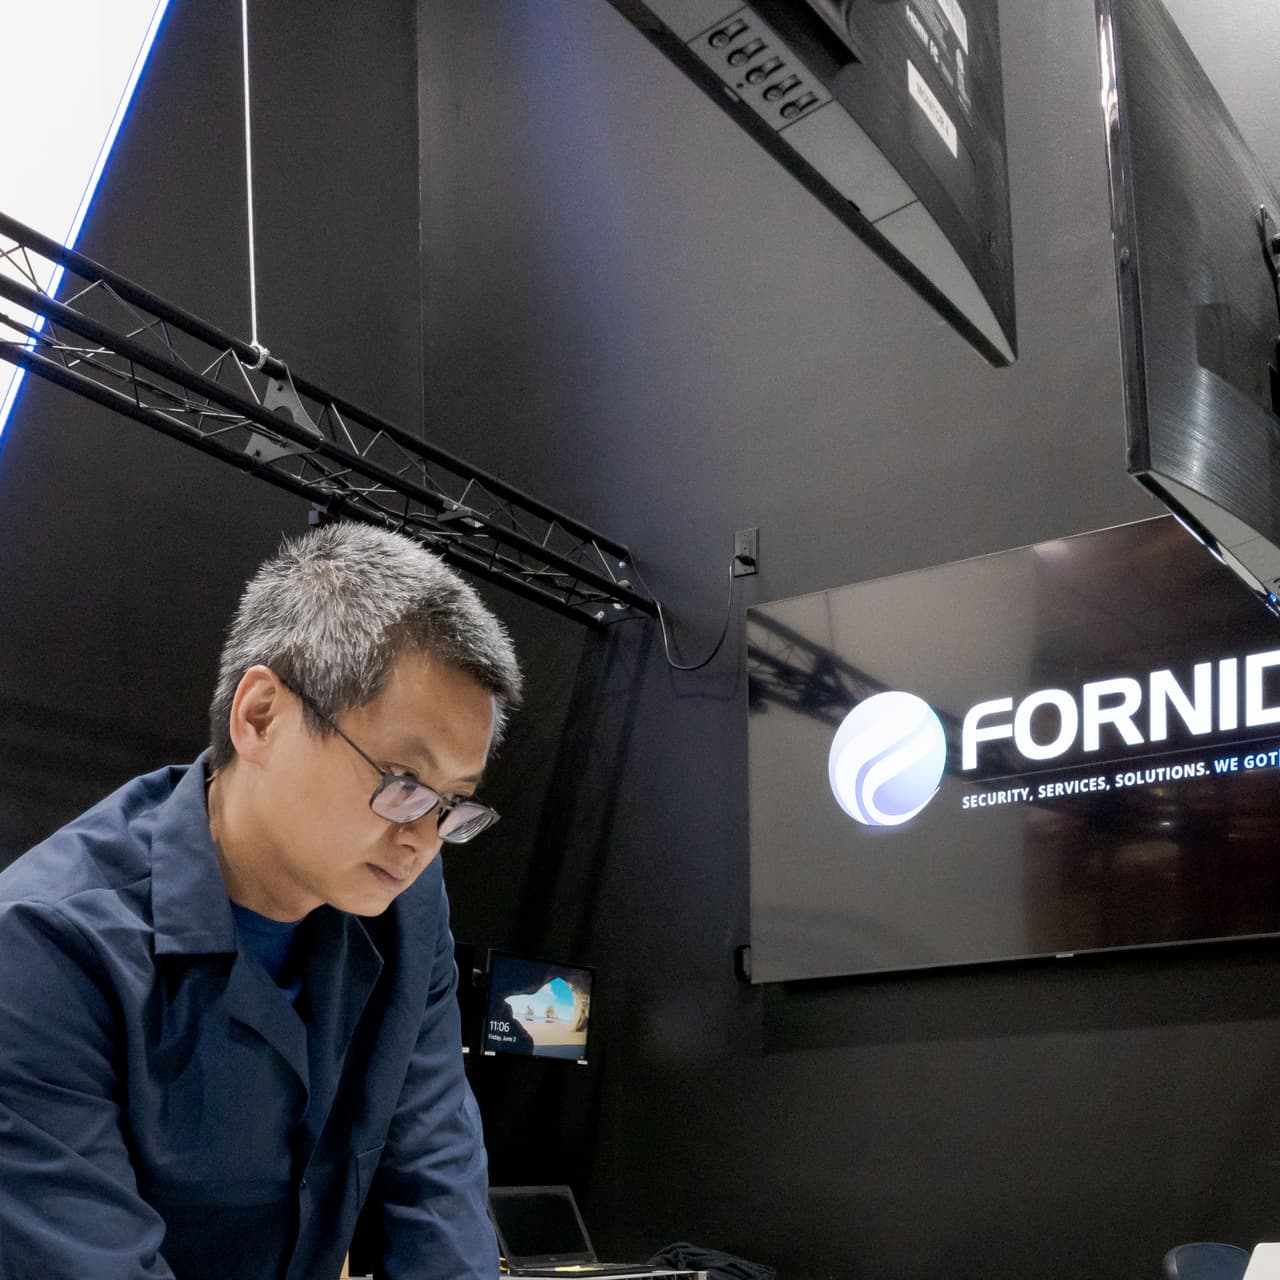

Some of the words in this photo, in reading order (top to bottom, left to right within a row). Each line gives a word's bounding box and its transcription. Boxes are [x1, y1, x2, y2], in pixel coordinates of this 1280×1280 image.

[962, 786, 1034, 809] SECURITY,
[1037, 775, 1111, 800] SERVICES,
[1115, 762, 1210, 788] SOLUTIONS.
[1214, 757, 1238, 773] WE
[1244, 752, 1279, 769] GOT
[490, 1020, 510, 1033] 11:06
